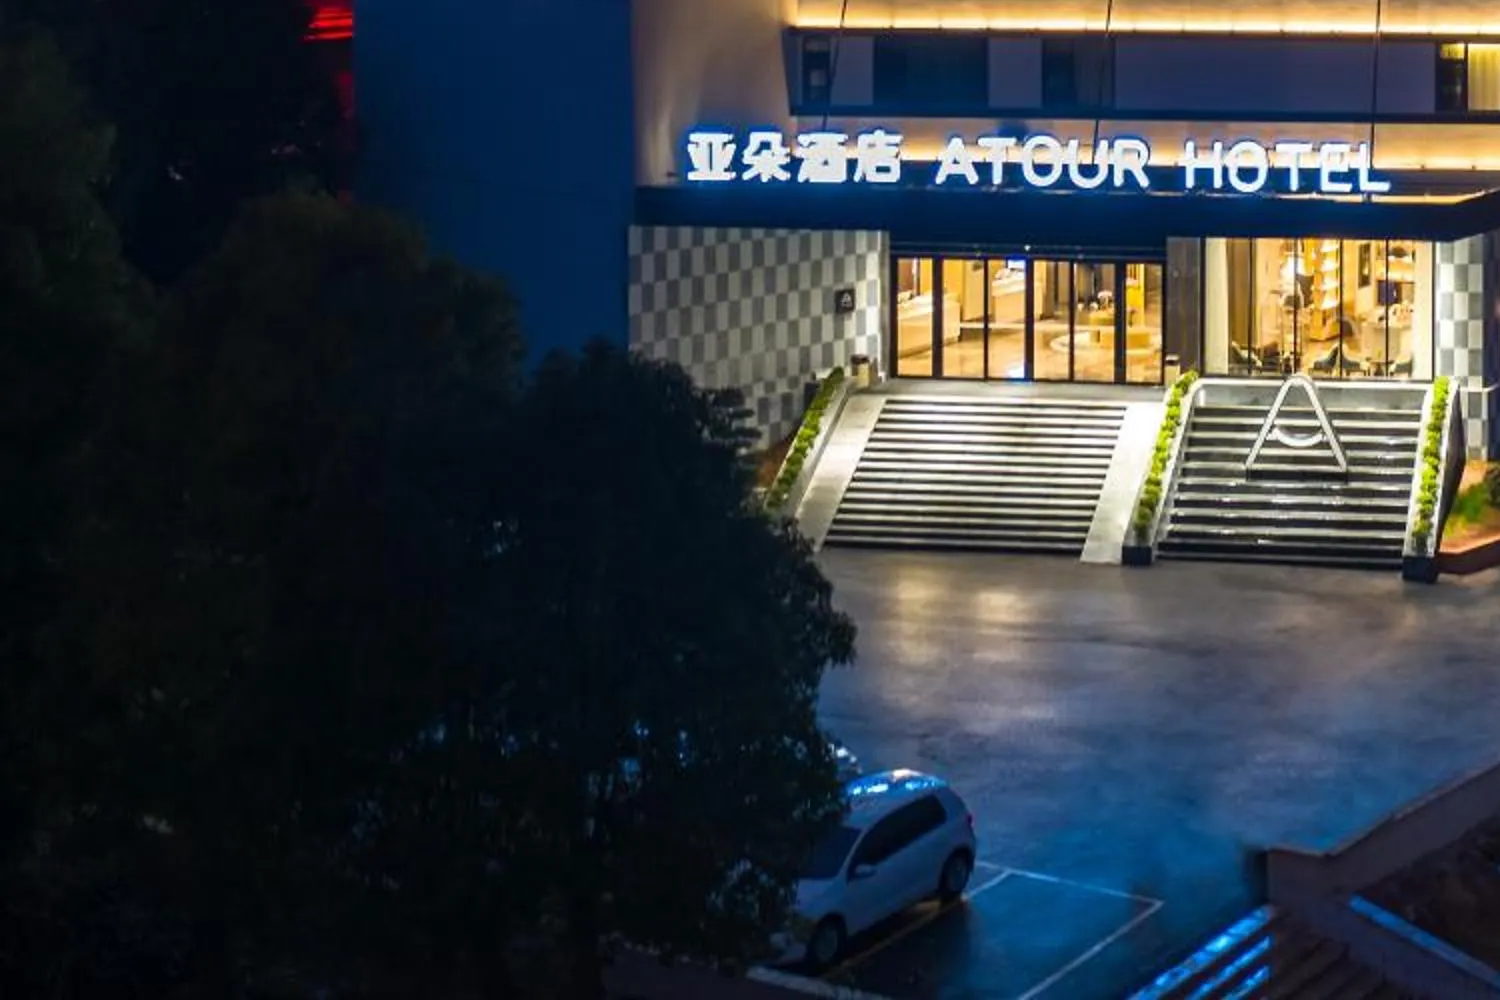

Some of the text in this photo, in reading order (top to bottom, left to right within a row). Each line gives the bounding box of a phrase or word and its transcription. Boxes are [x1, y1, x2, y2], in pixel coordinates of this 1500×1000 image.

[687, 131, 1391, 193] 亚朵酒店 ATOUR HOTEL
